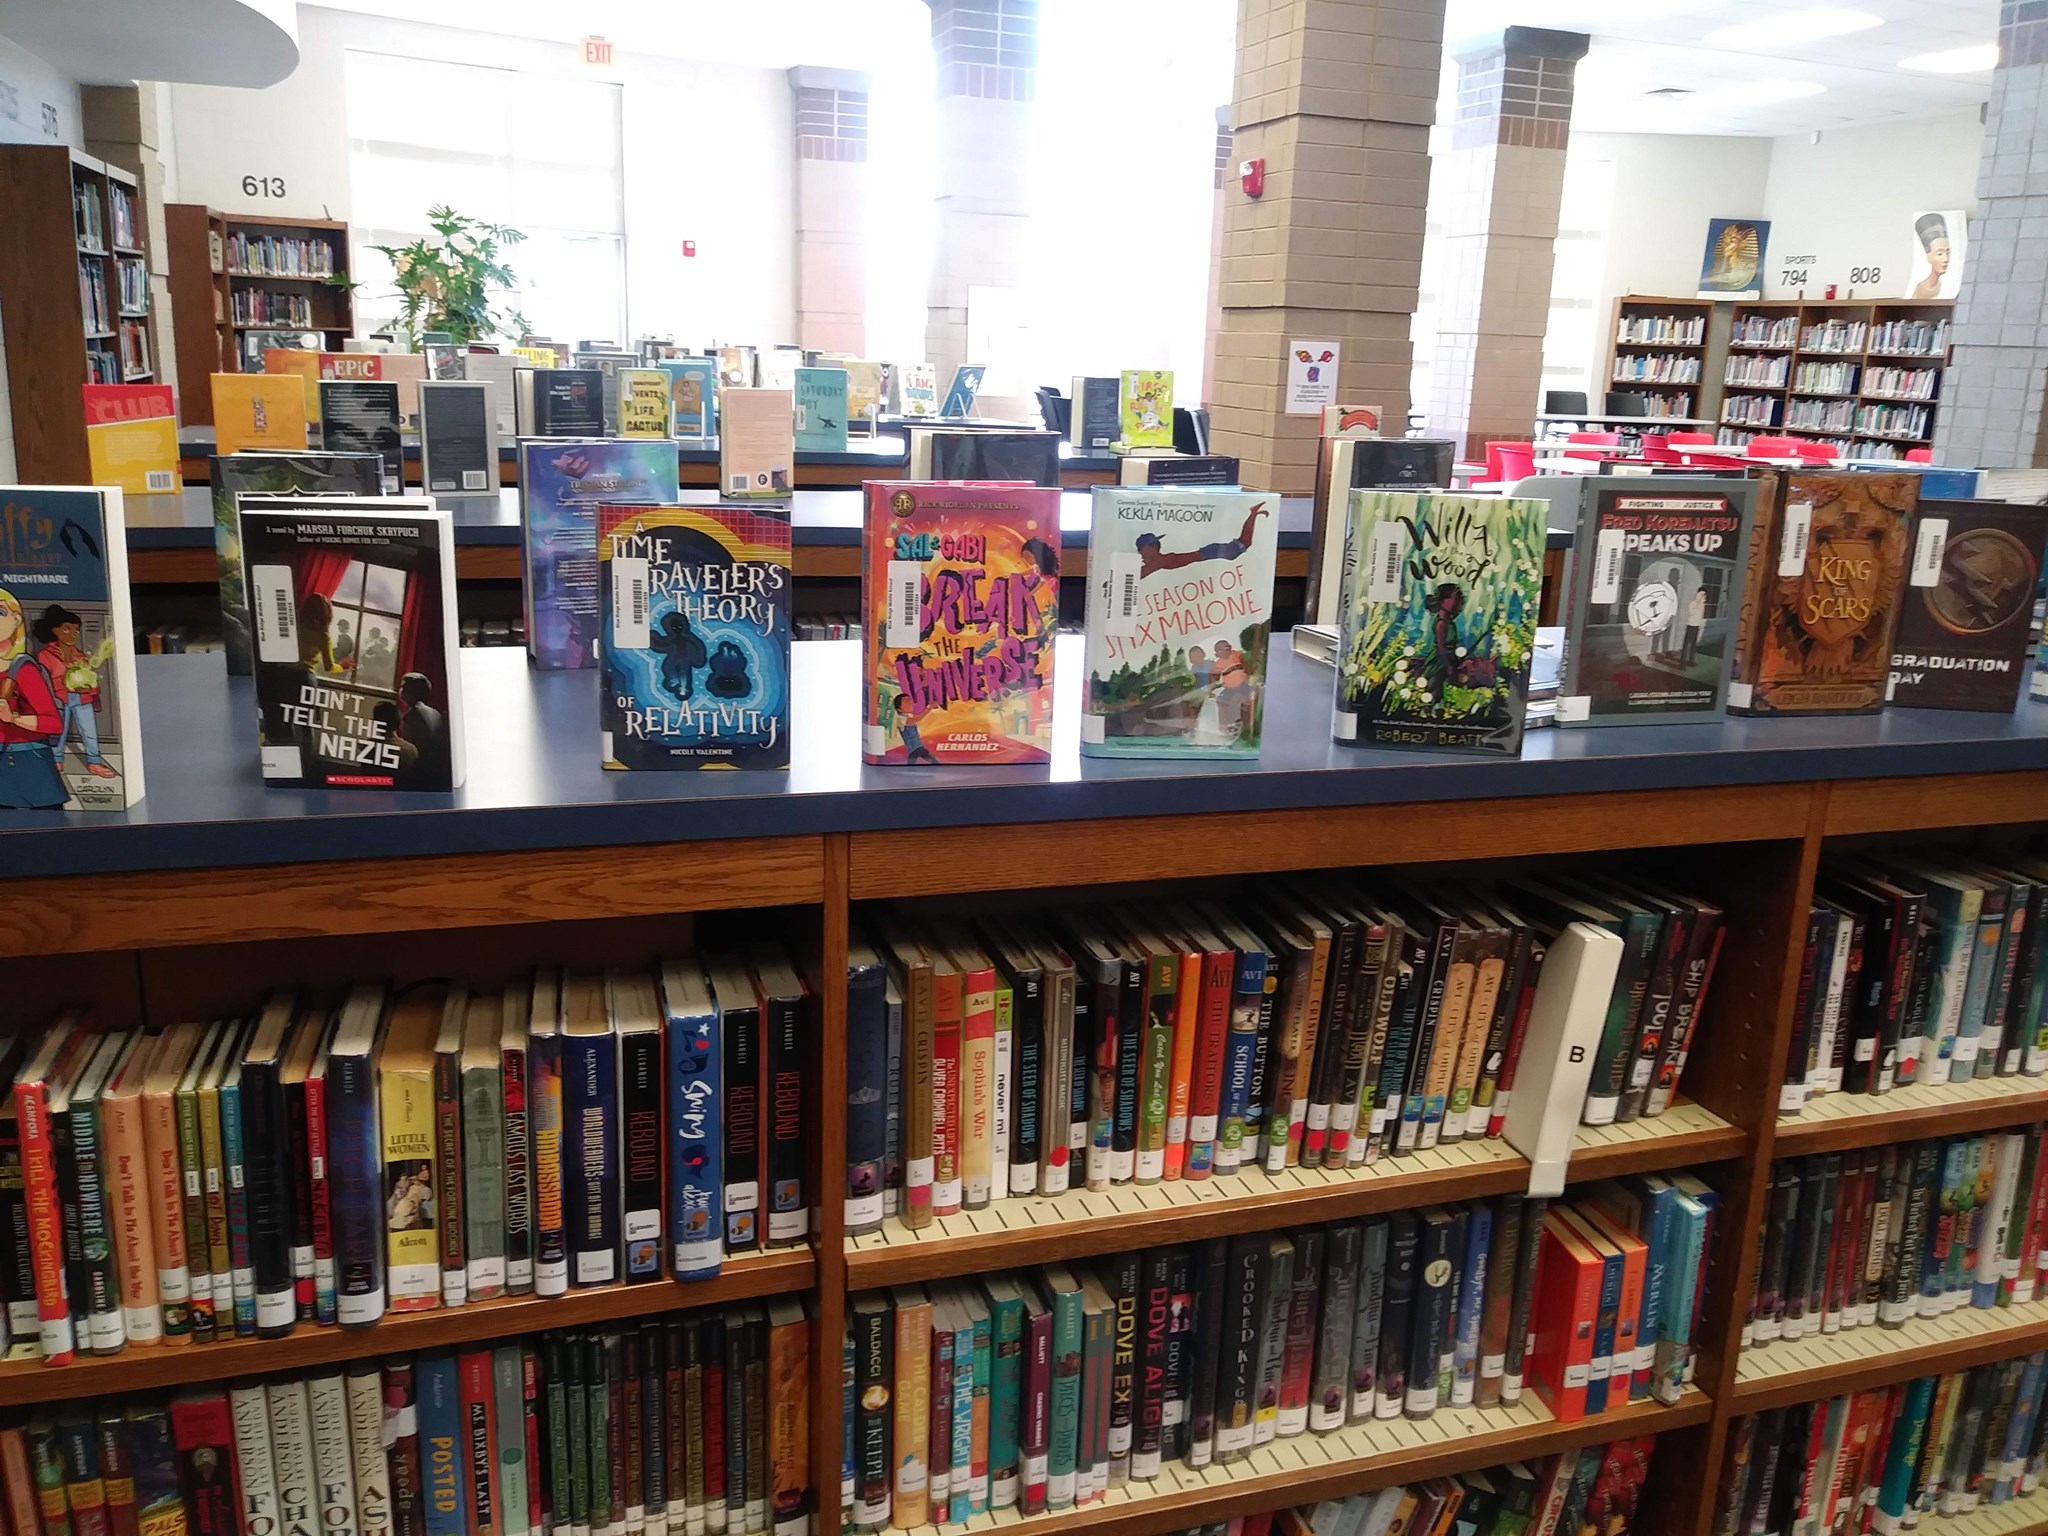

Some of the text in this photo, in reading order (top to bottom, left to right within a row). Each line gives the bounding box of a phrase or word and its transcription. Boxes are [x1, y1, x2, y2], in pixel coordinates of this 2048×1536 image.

[585, 43, 612, 63] EXIT
[242, 176, 286, 198] 613
[1781, 270, 1808, 286] 794
[1785, 256, 1816, 265] SPORTS
[1850, 268, 1881, 284] 808
[94, 395, 170, 422] CLUB
[800, 386, 844, 397] SATURDAY
[626, 421, 663, 431] CACTUS
[634, 407, 654, 415] LIFE
[1118, 507, 1213, 523] KEKLA MAGOON
[1601, 515, 1739, 531] FRED KOREMATSU
[1683, 501, 1714, 509] JUSTICE
[297, 525, 333, 535] MARSHA
[337, 526, 374, 536] FORCHUK
[377, 527, 419, 537] SKRYPUCH
[635, 521, 644, 532] A
[1621, 534, 1723, 552] SPEAKS UP
[607, 533, 672, 565] TIME
[896, 532, 933, 560] SAL
[940, 533, 987, 564] GABI
[4, 574, 69, 585] NIGHTMARE
[650, 562, 783, 600] RAVELER'S
[1816, 556, 1872, 586] KING
[1145, 565, 1245, 617] SEASON OF
[1834, 587, 1847, 595] OF
[673, 591, 775, 637] THEORY
[1158, 588, 1263, 641] MALONE
[1804, 595, 1870, 625] SCARS
[934, 637, 961, 657] THE
[1891, 654, 2010, 672] GRADUATION
[895, 638, 1044, 714] UNIVERSE
[300, 686, 365, 714] DON'T
[617, 696, 635, 708] OF
[280, 703, 387, 740] TELL THE
[625, 700, 779, 749] RELATIVITY
[318, 733, 401, 769] NAZIS
[936, 743, 999, 751] HERNANDEZ
[1414, 948, 1426, 964] AVI
[1439, 934, 1453, 957] AVI
[1026, 982, 1038, 998] AVI
[1161, 965, 1171, 988] AVI
[1242, 970, 1262, 981] AVI
[1303, 1000, 1321, 1052] CRISPIN
[1370, 976, 1396, 1065] OLD WOLF
[1643, 993, 1672, 1034] TOOL
[1665, 958, 1705, 1064] SHIP BREAK
[738, 1025, 747, 1064] ALEXANDER
[784, 1011, 793, 1050] ALEXANDER
[1251, 1000, 1272, 1095] THE BUTTON
[586, 1048, 597, 1097] ALEXANDER
[637, 1049, 647, 1089] ALEXANDER
[917, 1031, 929, 1085] CRISPIN
[1231, 1045, 1248, 1093] SCHOOL
[1570, 1046, 1585, 1063] B
[1020, 1042, 1037, 1144] THE SEER OF SHADOWS
[1057, 1039, 1068, 1110] MIDNIGHT MAGIC
[1118, 1032, 1138, 1132] THE SEER OF SHADOWS
[678, 1080, 713, 1139] Swing
[774, 1072, 800, 1140] REBOUND
[933, 1058, 947, 1155] OLIVER CROMWELL PITTS
[973, 1051, 986, 1139] Sophia's War
[23, 1095, 40, 1139] ACAMPORA
[443, 1113, 453, 1127] THE
[729, 1086, 755, 1155] REBOUND
[387, 1144, 430, 1154] WOMEN
[389, 1134, 428, 1144] LITTLE
[443, 1130, 454, 1155] SECRET
[629, 1111, 656, 1182] REBOUND
[28, 1156, 45, 1184] KILL
[72, 1112, 104, 1235] MIDDLE NOWHERE
[445, 1159, 454, 1169] OF
[445, 1172, 454, 1185] THE
[506, 1112, 528, 1234] FAMOUS LAST WORDS
[536, 1130, 561, 1232] AMBASSADOR
[31, 1188, 47, 1213] THE
[445, 1187, 456, 1219] FORTUNE
[63, 1204, 80, 1261] FAMILY BUSINESS
[1874, 1207, 1888, 1234] DOLL
[398, 1238, 427, 1248] Alcott
[34, 1218, 59, 1306] MOCKINGBIRD
[1241, 1253, 1257, 1343] CROOKED
[1603, 1267, 1617, 1304] MERLIN
[1645, 1264, 1664, 1329] MERLIN
[1066, 1302, 1075, 1339] BALLIETT
[1115, 1297, 1136, 1365] DOVE
[1146, 1287, 1167, 1356] DOVE
[870, 1318, 881, 1376] BALDACCI
[897, 1380, 911, 1423] GAME
[912, 1354, 926, 1444] THE CALDER
[235, 1399, 257, 1489] ANDERSON
[271, 1394, 293, 1484] ANDERSON
[429, 1437, 456, 1513] POSTED
[471, 1404, 490, 1514] MS. BIXBY'S LAST
